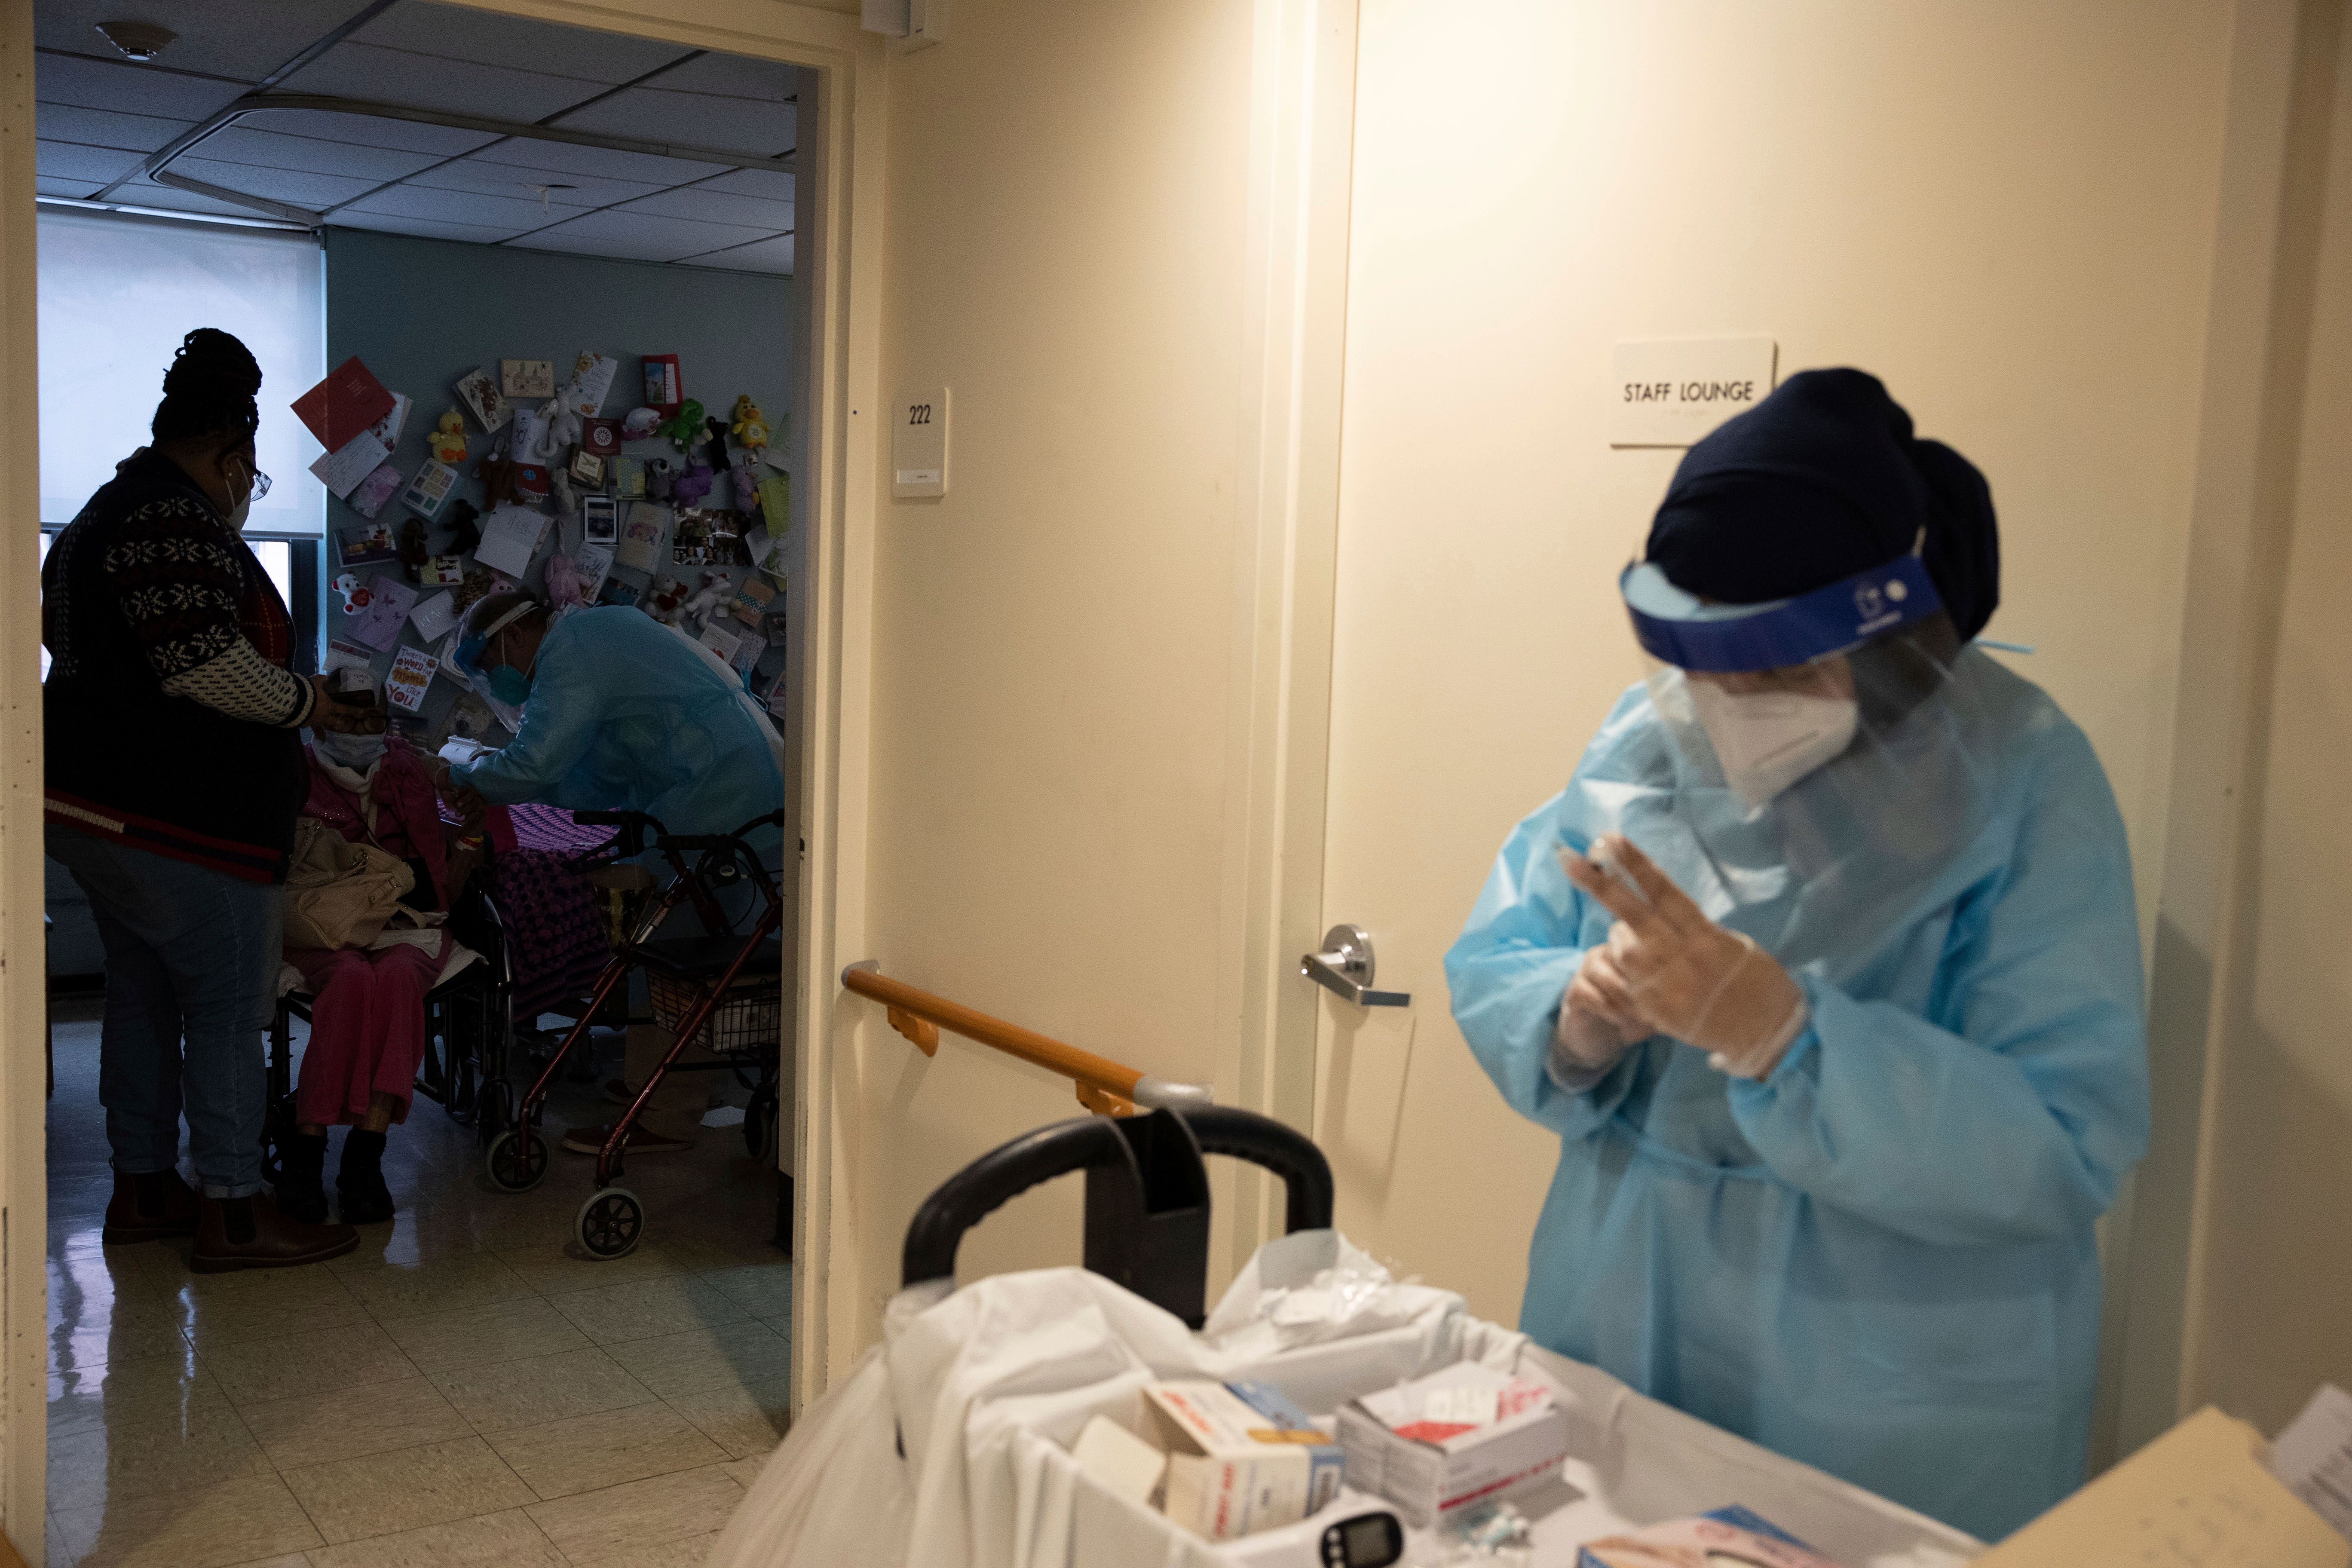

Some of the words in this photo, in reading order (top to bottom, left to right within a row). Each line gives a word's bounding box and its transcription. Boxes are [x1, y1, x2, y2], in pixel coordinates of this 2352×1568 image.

[1624, 382, 1672, 402] STAFF
[1680, 380, 1754, 402] LOUNGE
[910, 404, 931, 425] 222
